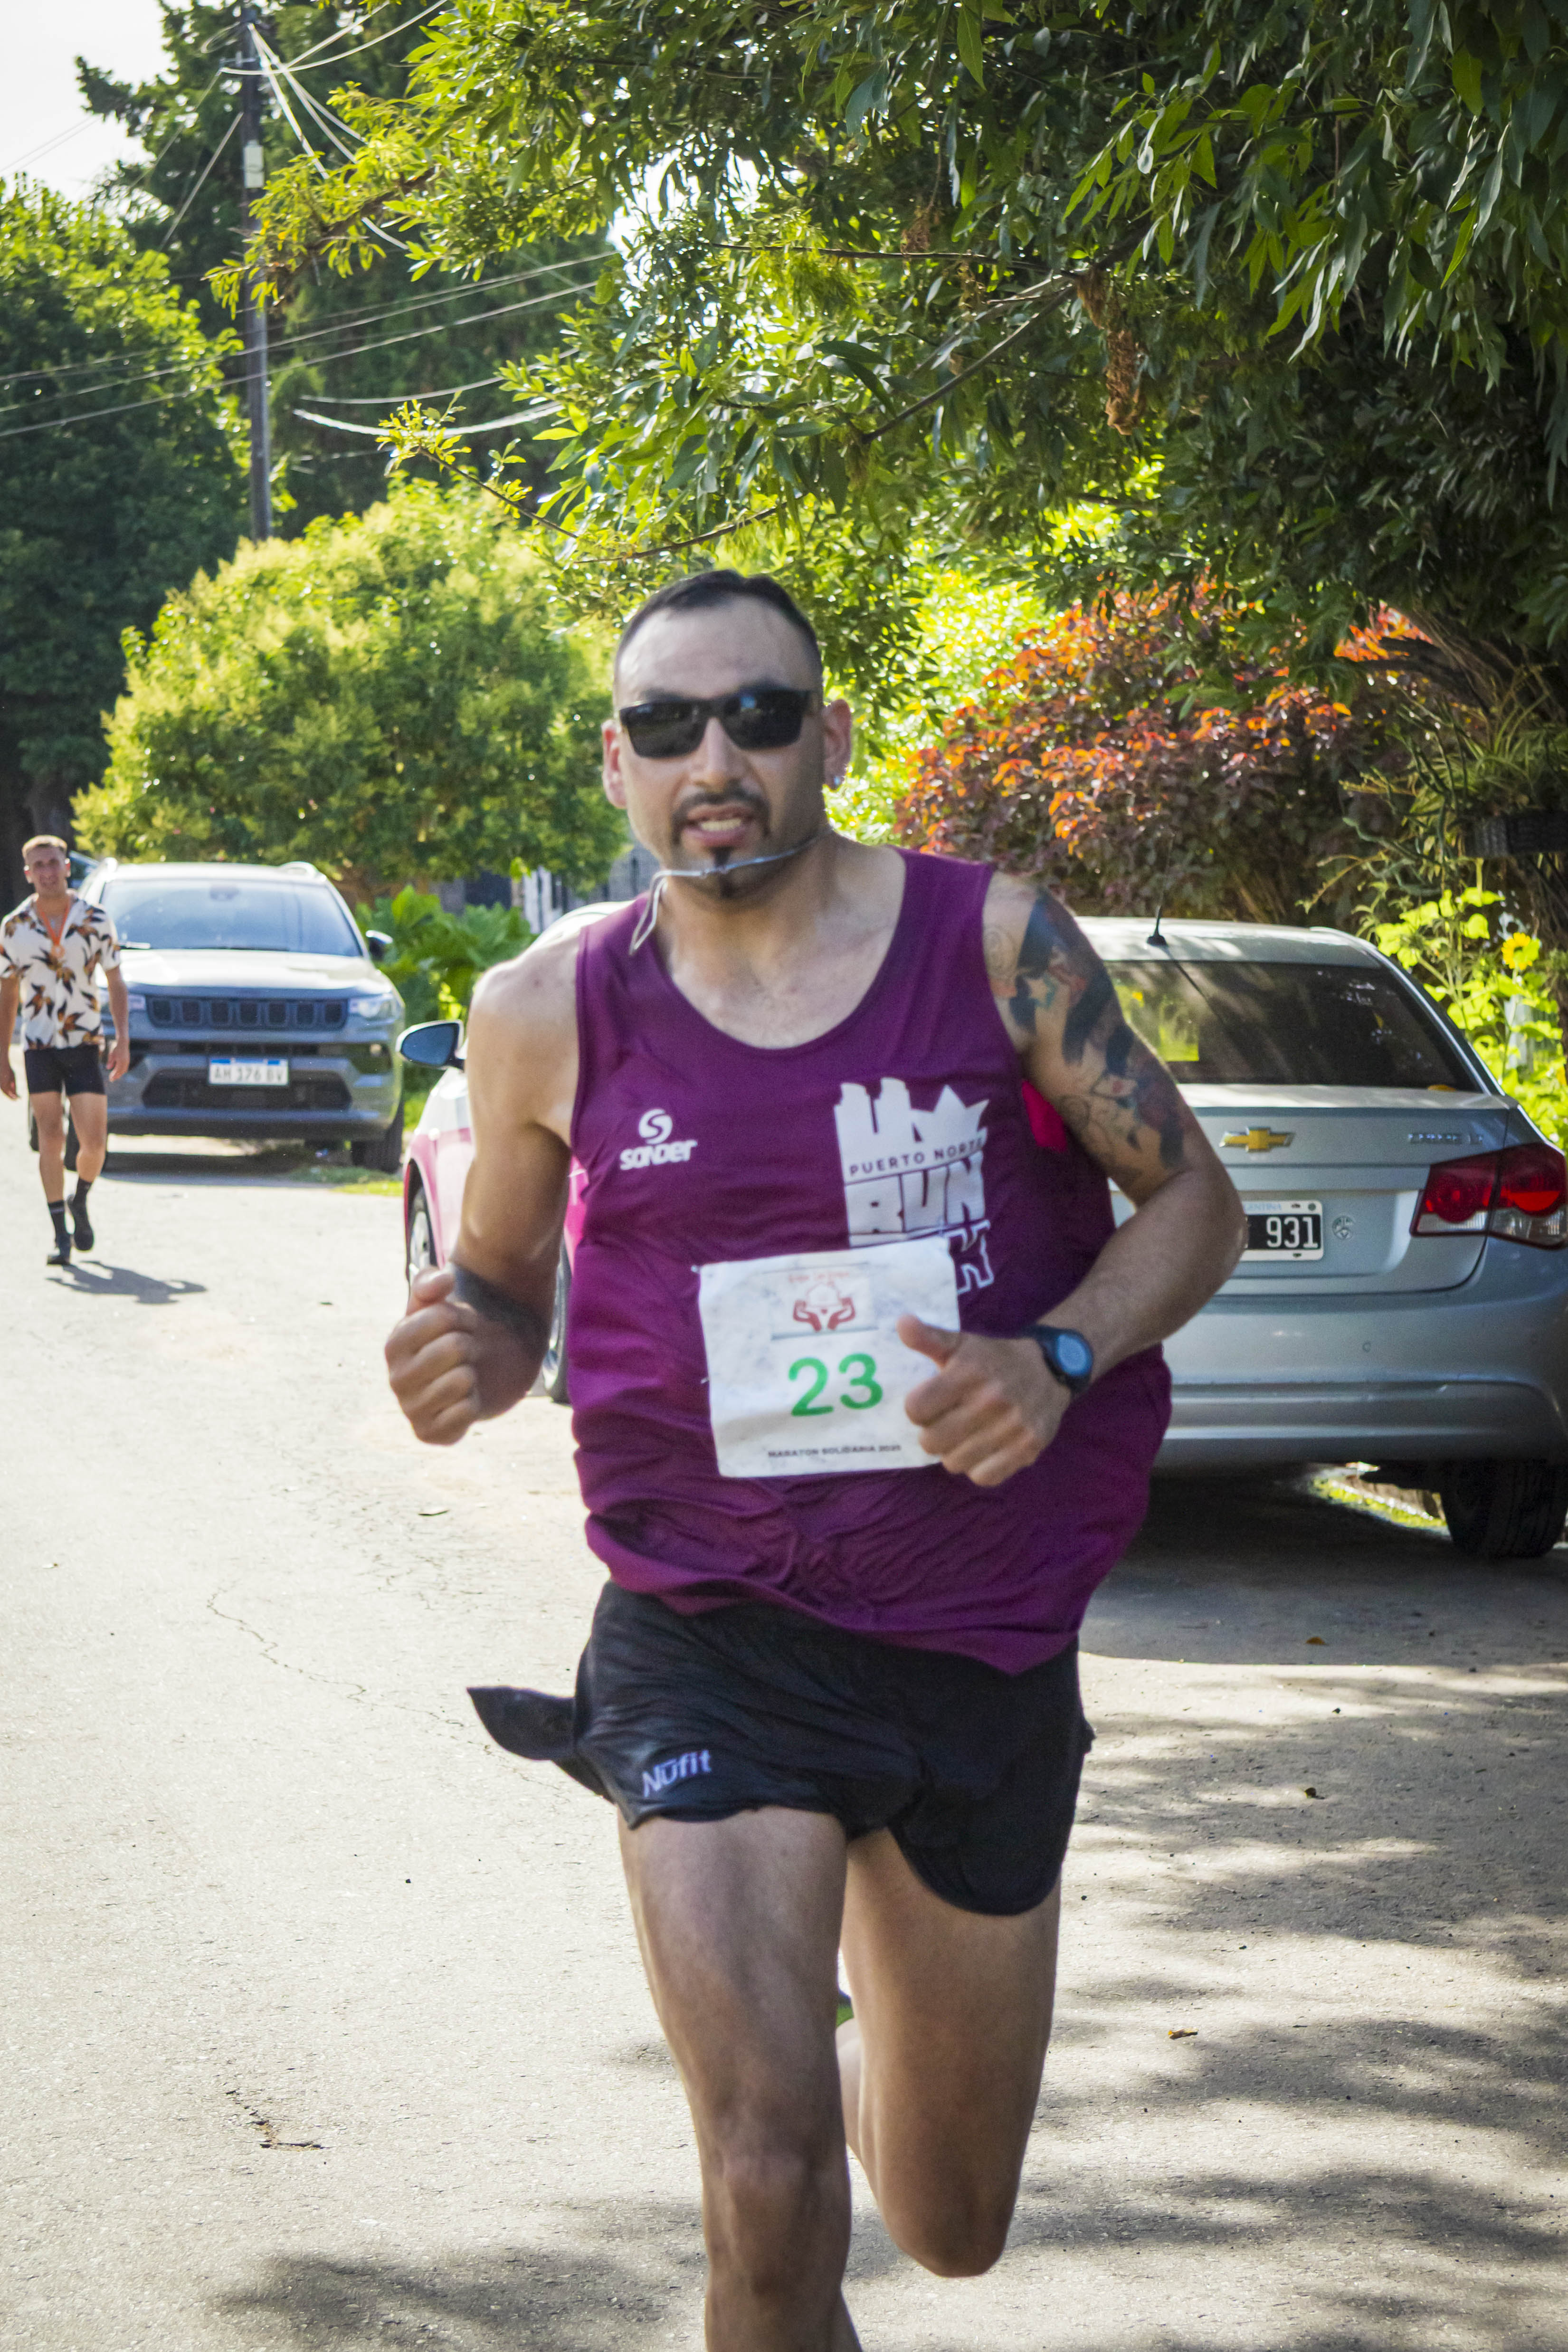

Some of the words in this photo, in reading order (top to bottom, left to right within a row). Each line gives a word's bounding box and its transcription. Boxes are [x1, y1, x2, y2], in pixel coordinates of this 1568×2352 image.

[849, 1151, 925, 1176] PUERTO
[1266, 1216, 1319, 1248] 931
[789, 1352, 883, 1417] 23
